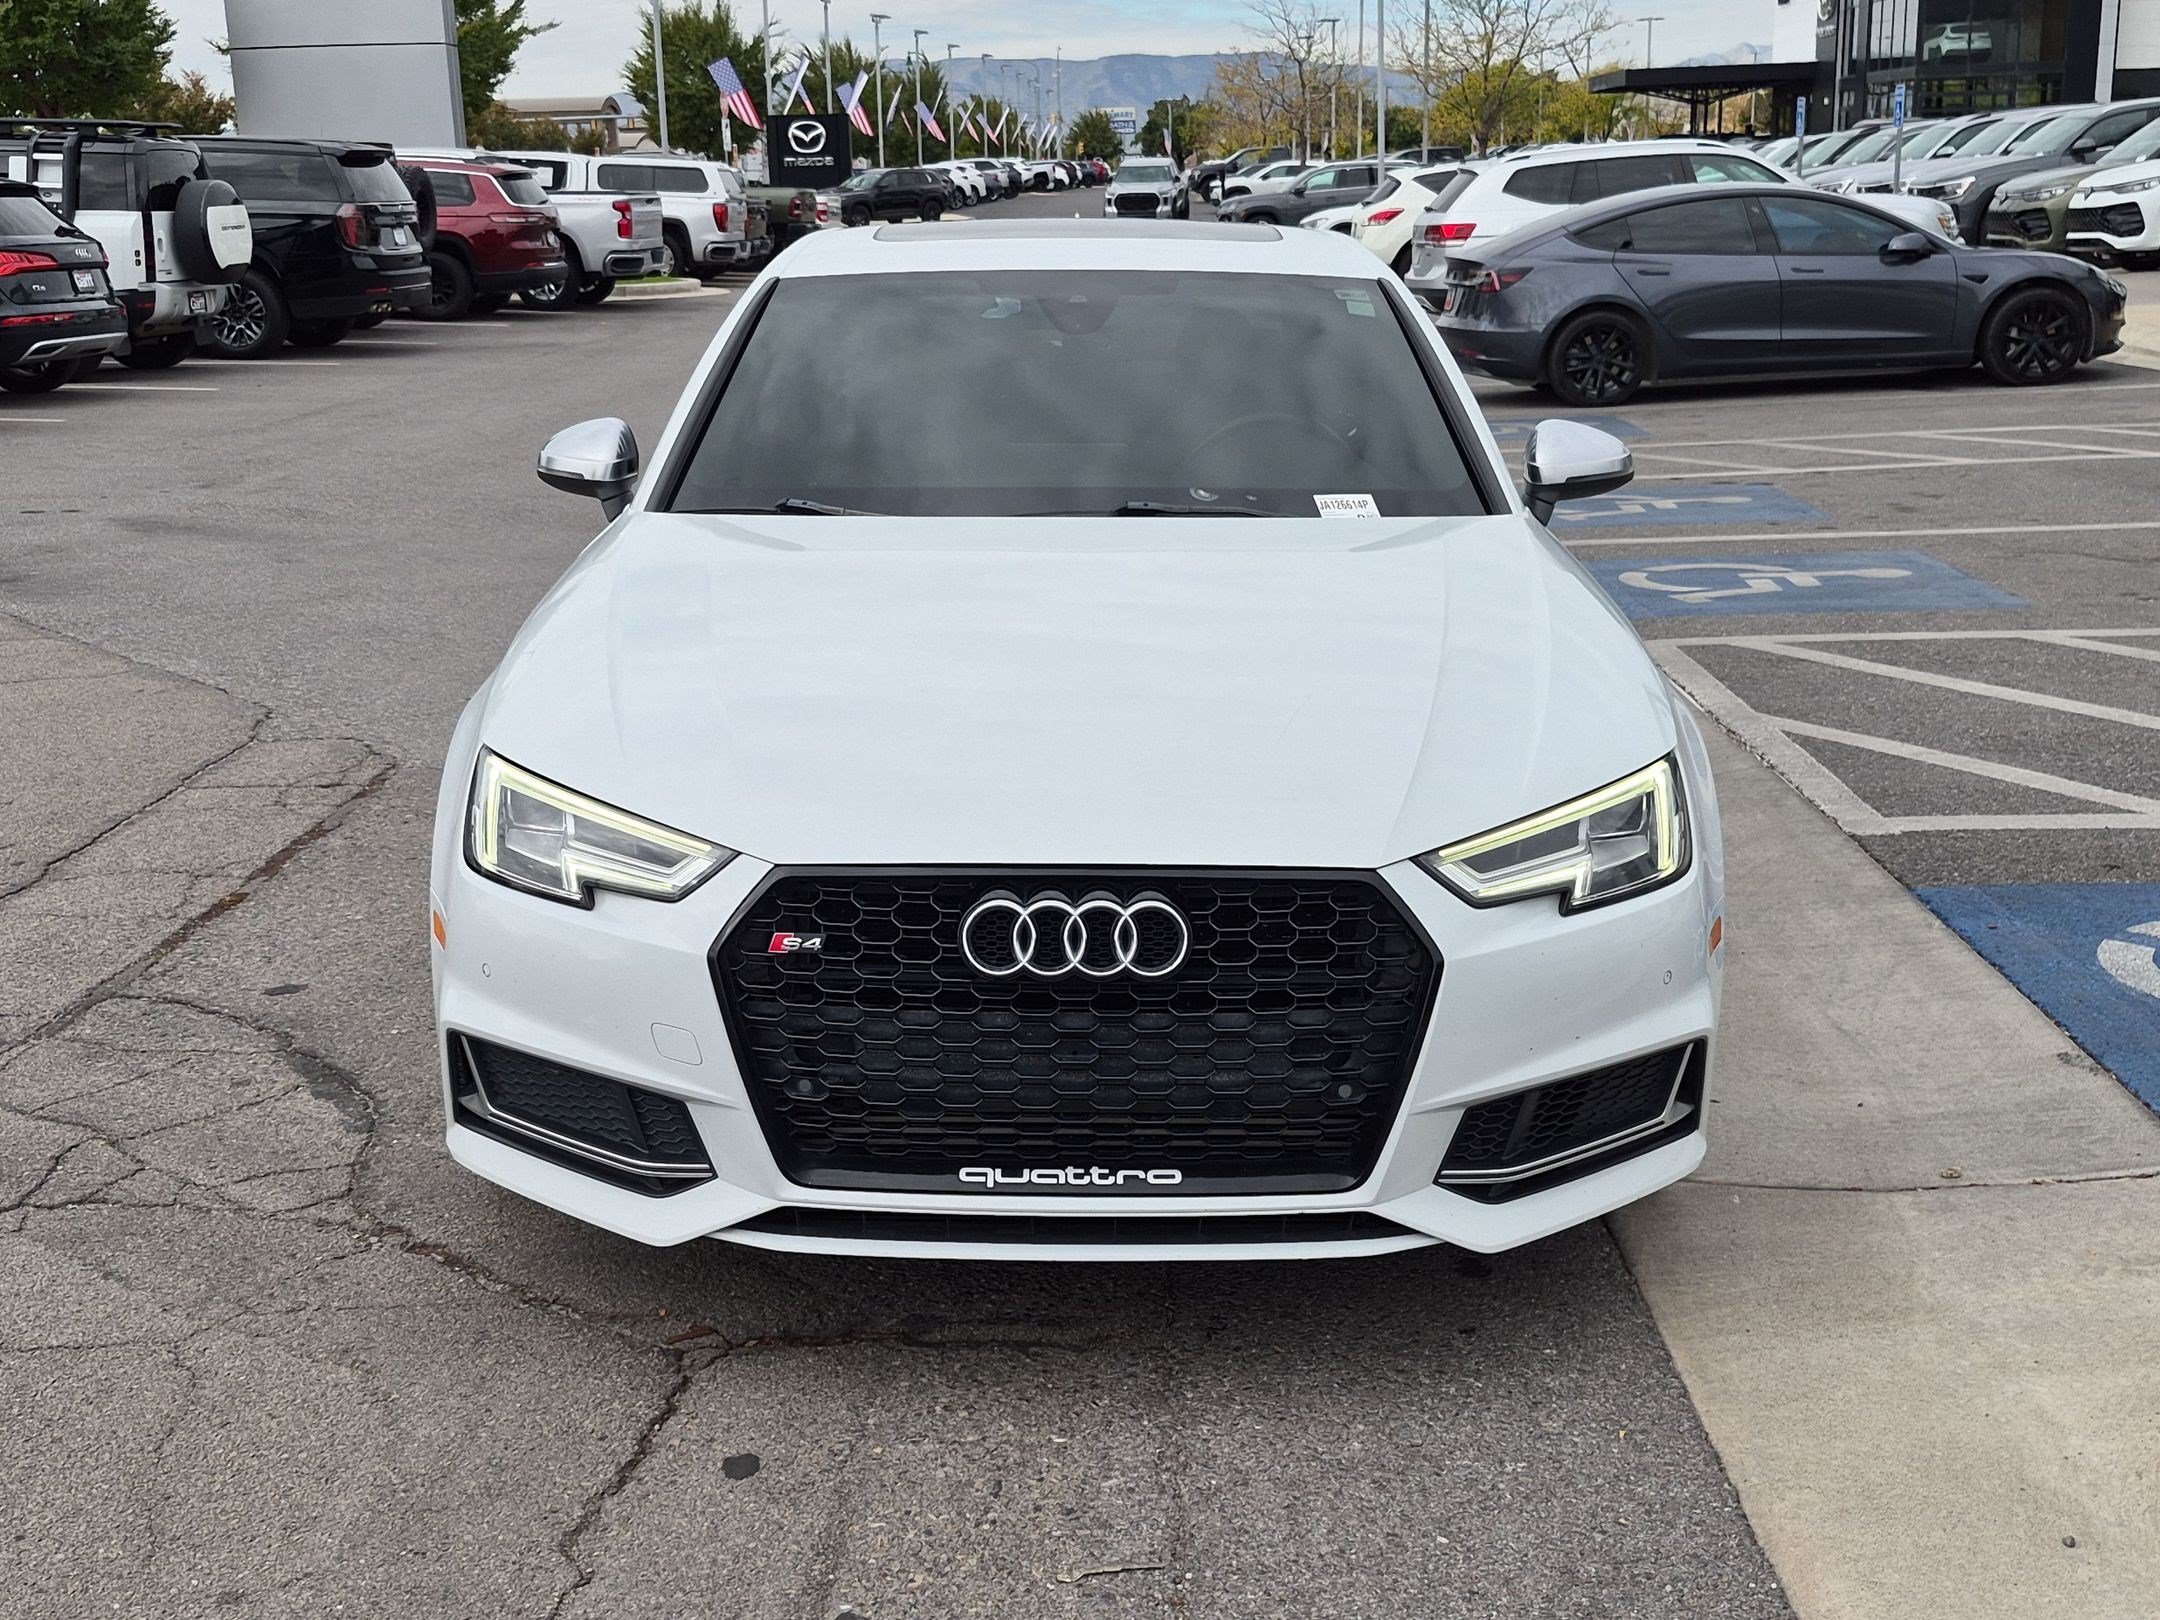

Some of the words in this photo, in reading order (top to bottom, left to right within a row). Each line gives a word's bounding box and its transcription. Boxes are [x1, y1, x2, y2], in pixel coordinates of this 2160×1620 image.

[1320, 499, 1369, 510] JA126614P
[780, 936, 822, 952] S4
[958, 1166, 1183, 1188] quattro
